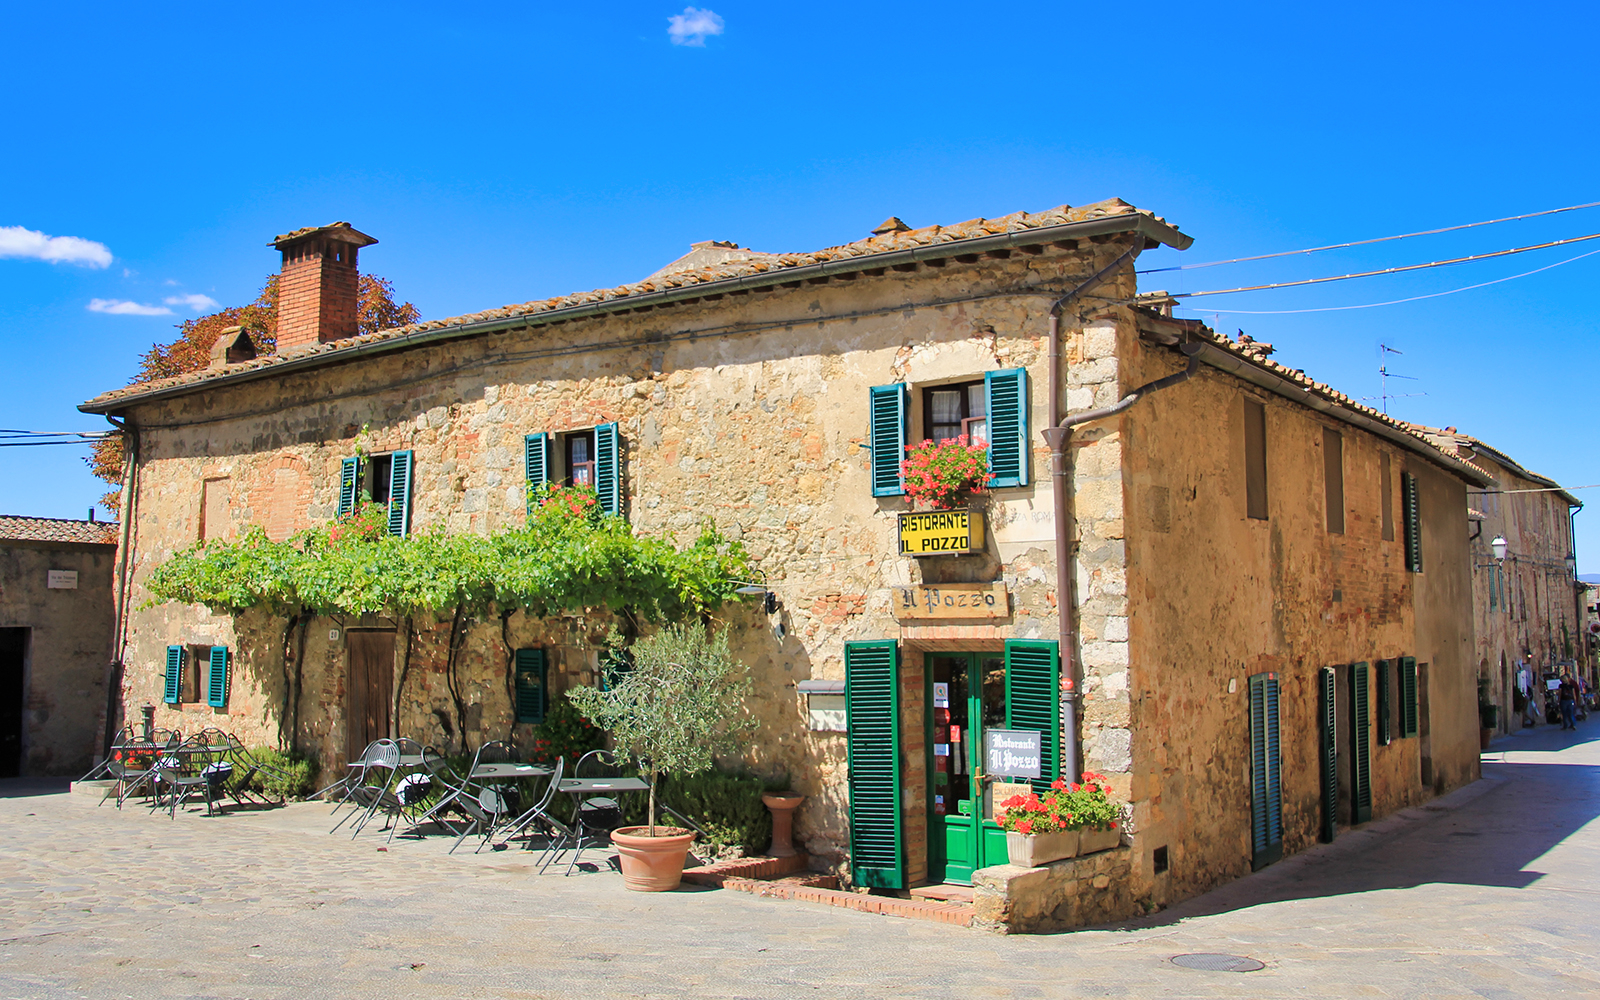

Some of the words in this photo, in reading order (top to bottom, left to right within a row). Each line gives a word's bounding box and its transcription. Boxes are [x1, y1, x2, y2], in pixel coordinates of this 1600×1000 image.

[901, 513, 968, 532] RISTORANTE
[902, 540, 914, 552] IL
[922, 536, 968, 551] POZZO
[902, 588, 917, 608] Il
[924, 588, 995, 614] Pozzo
[992, 733, 1036, 749] Ristorante
[990, 749, 1003, 769] Il
[1003, 748, 1039, 771] Pozzo
